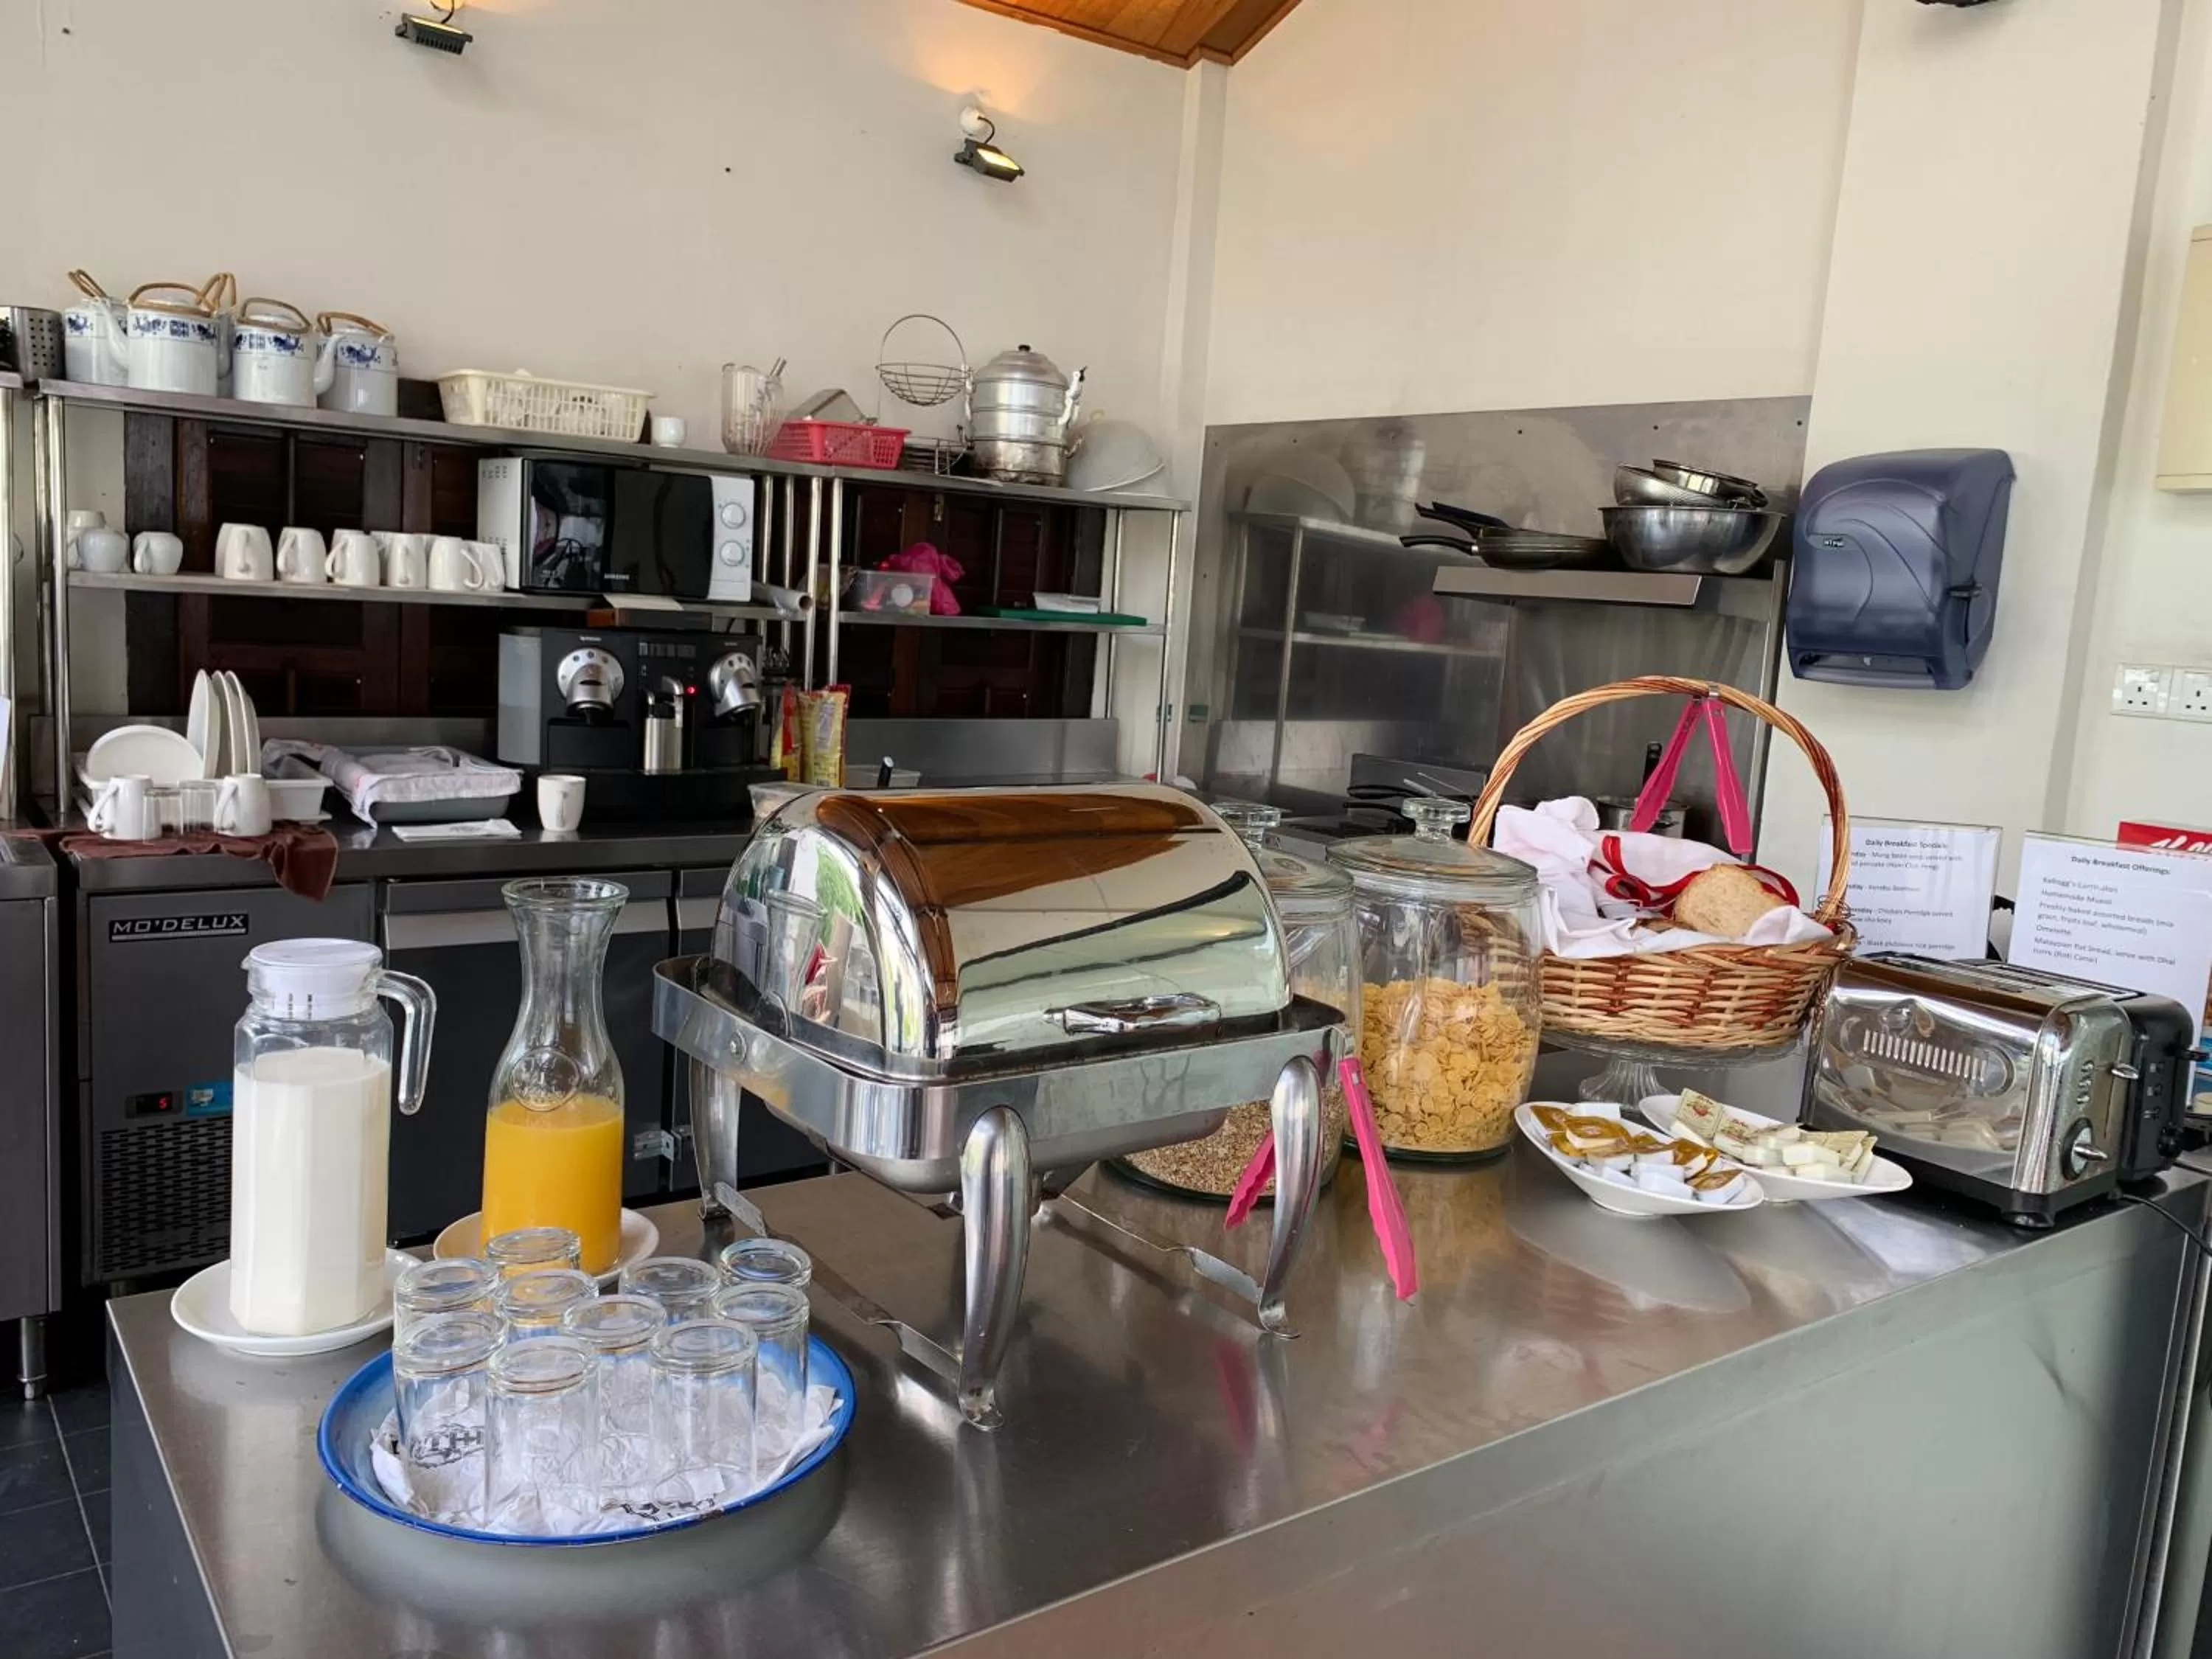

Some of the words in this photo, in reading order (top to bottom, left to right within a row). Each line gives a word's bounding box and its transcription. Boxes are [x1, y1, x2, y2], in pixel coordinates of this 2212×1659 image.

[2071, 856, 2090, 866] Daily
[2093, 859, 2130, 870] Breakfast
[113, 915, 246, 934] MO'DELUX
